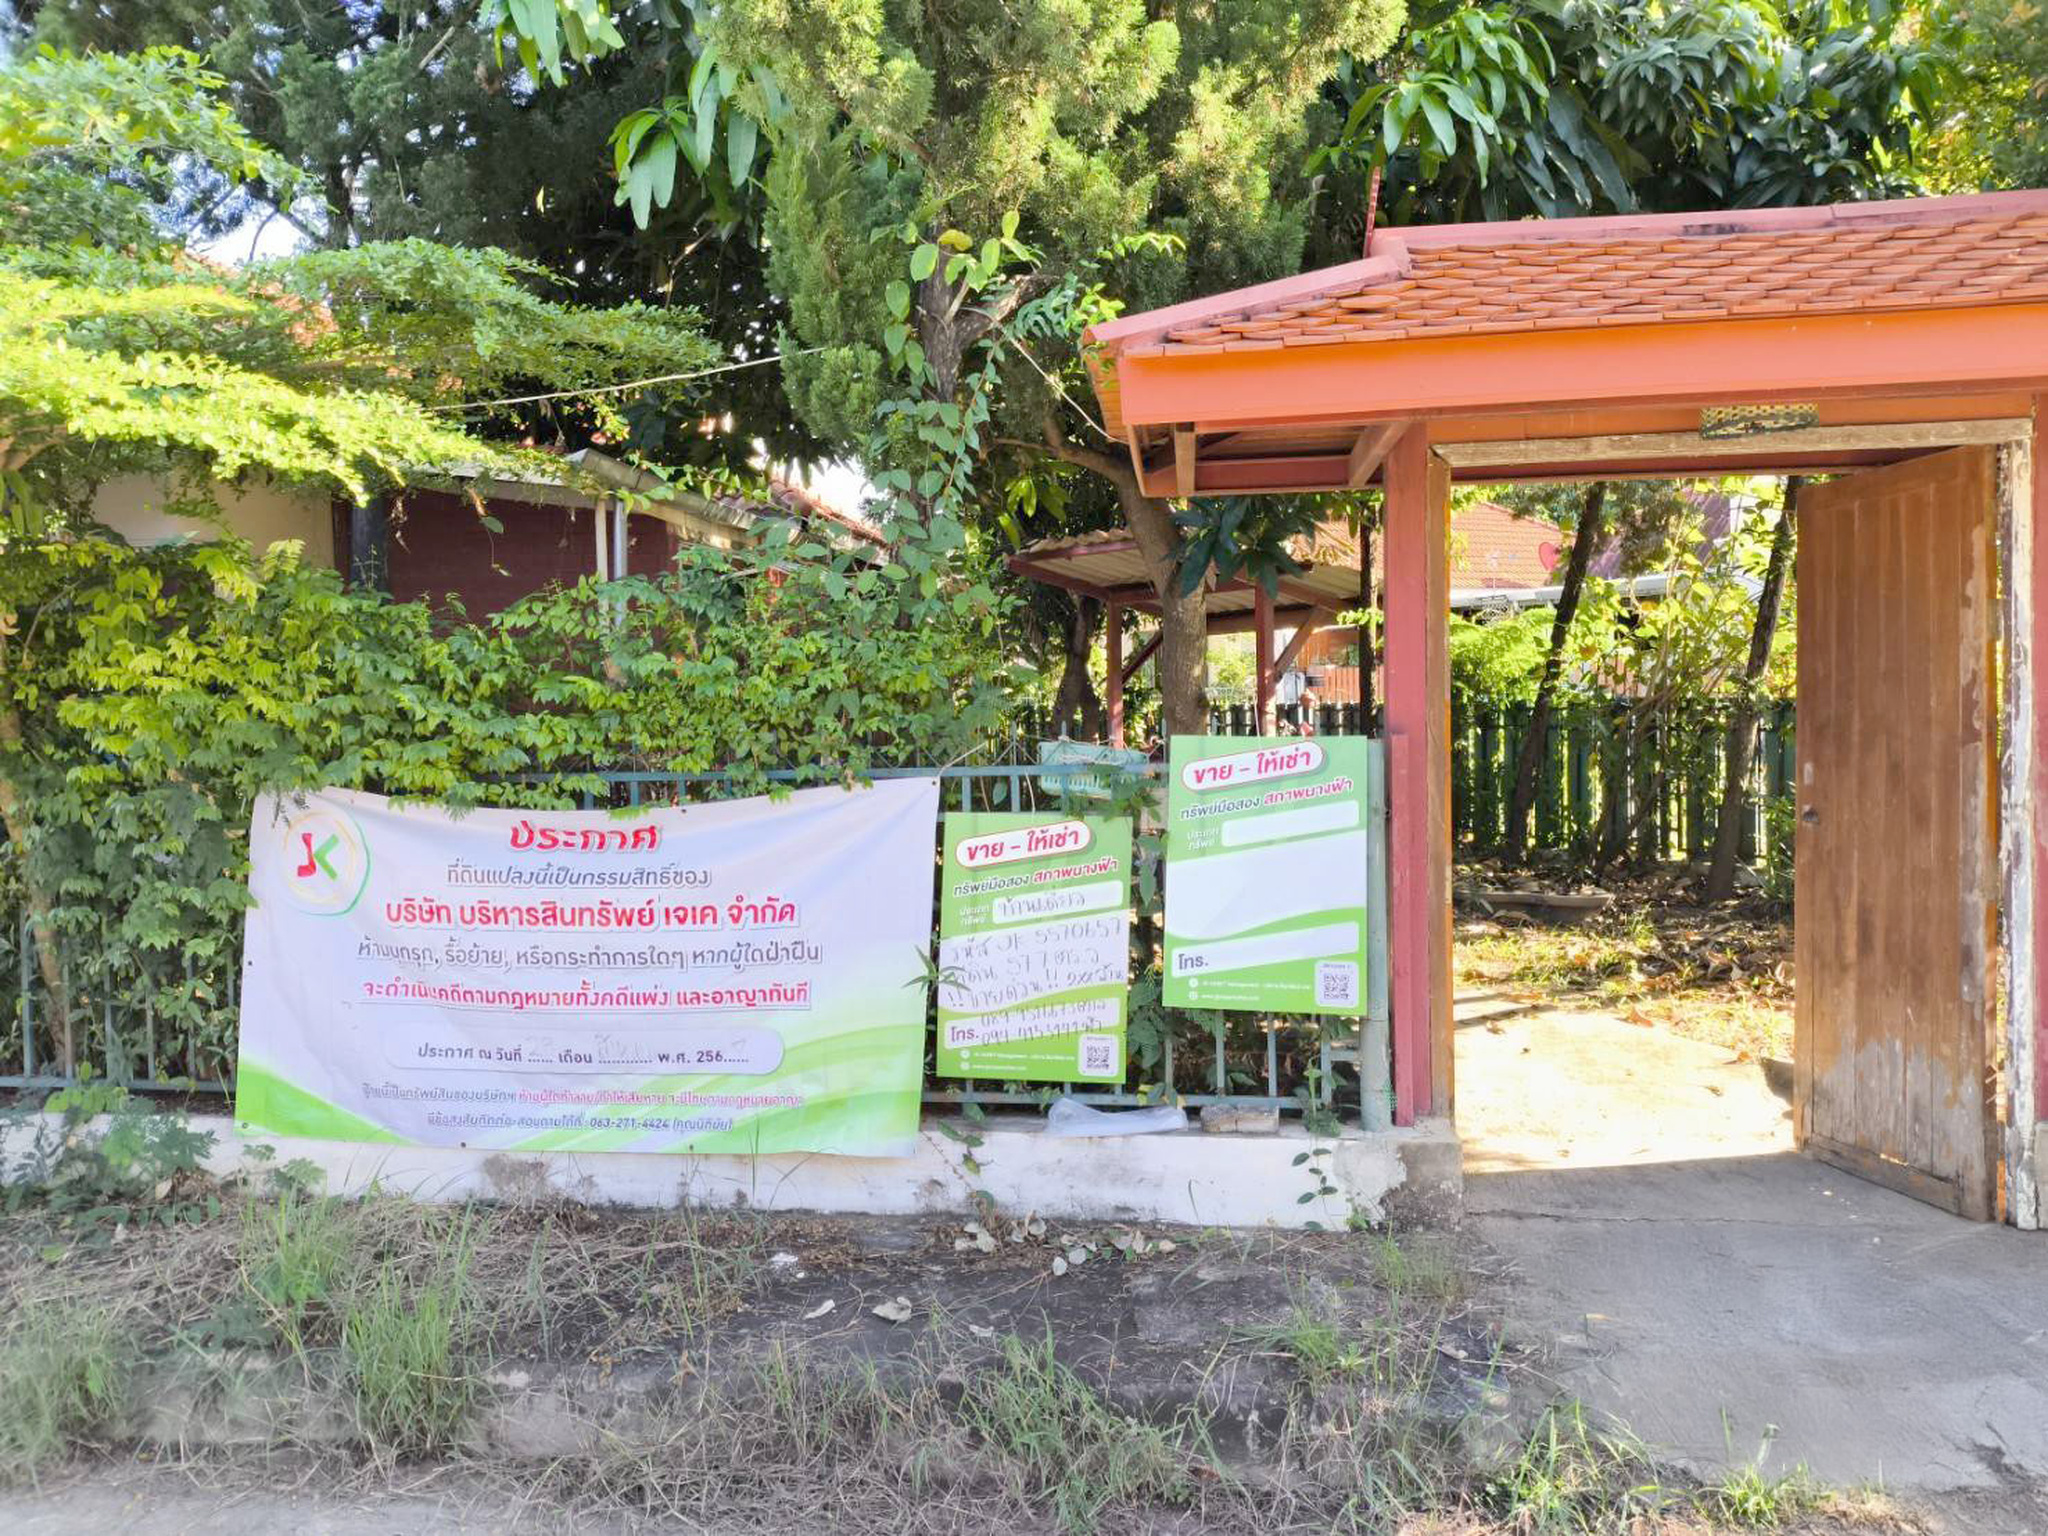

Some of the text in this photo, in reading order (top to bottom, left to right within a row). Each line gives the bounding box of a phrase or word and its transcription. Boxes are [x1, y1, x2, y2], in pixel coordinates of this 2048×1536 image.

[1193, 763, 1233, 784] ขาย
[1256, 747, 1312, 775] ให้เช่า
[1263, 776, 1353, 805] สภาพนางฟ้า
[509, 820, 659, 850] ประกาศ
[967, 841, 1004, 861] ขาย
[1026, 826, 1081, 853] ให้เช่า
[296, 832, 340, 882] JK
[447, 857, 710, 887] ที่ดินแปลงนี้เป็นกรรมสิทธิ์ของ
[1033, 856, 1118, 884] สภาพนางฟ้า
[386, 894, 796, 928] บริษัท บริหารสินทรัพย์ เจเค จำกัด
[516, 944, 685, 970] หรือกระทำการใดๆ
[692, 940, 820, 970] หากผู้ใดฝ่าฝืน
[1178, 953, 1209, 970] โทร.
[677, 981, 808, 1007] และอาญาทันที
[951, 1026, 979, 1043] โทร.
[417, 1042, 474, 1059] ประกาศ
[478, 1049, 492, 1060] ณ
[495, 1044, 523, 1063] วันที่
[558, 1048, 593, 1064] เดือน
[657, 1052, 691, 1064] พ.ศ.
